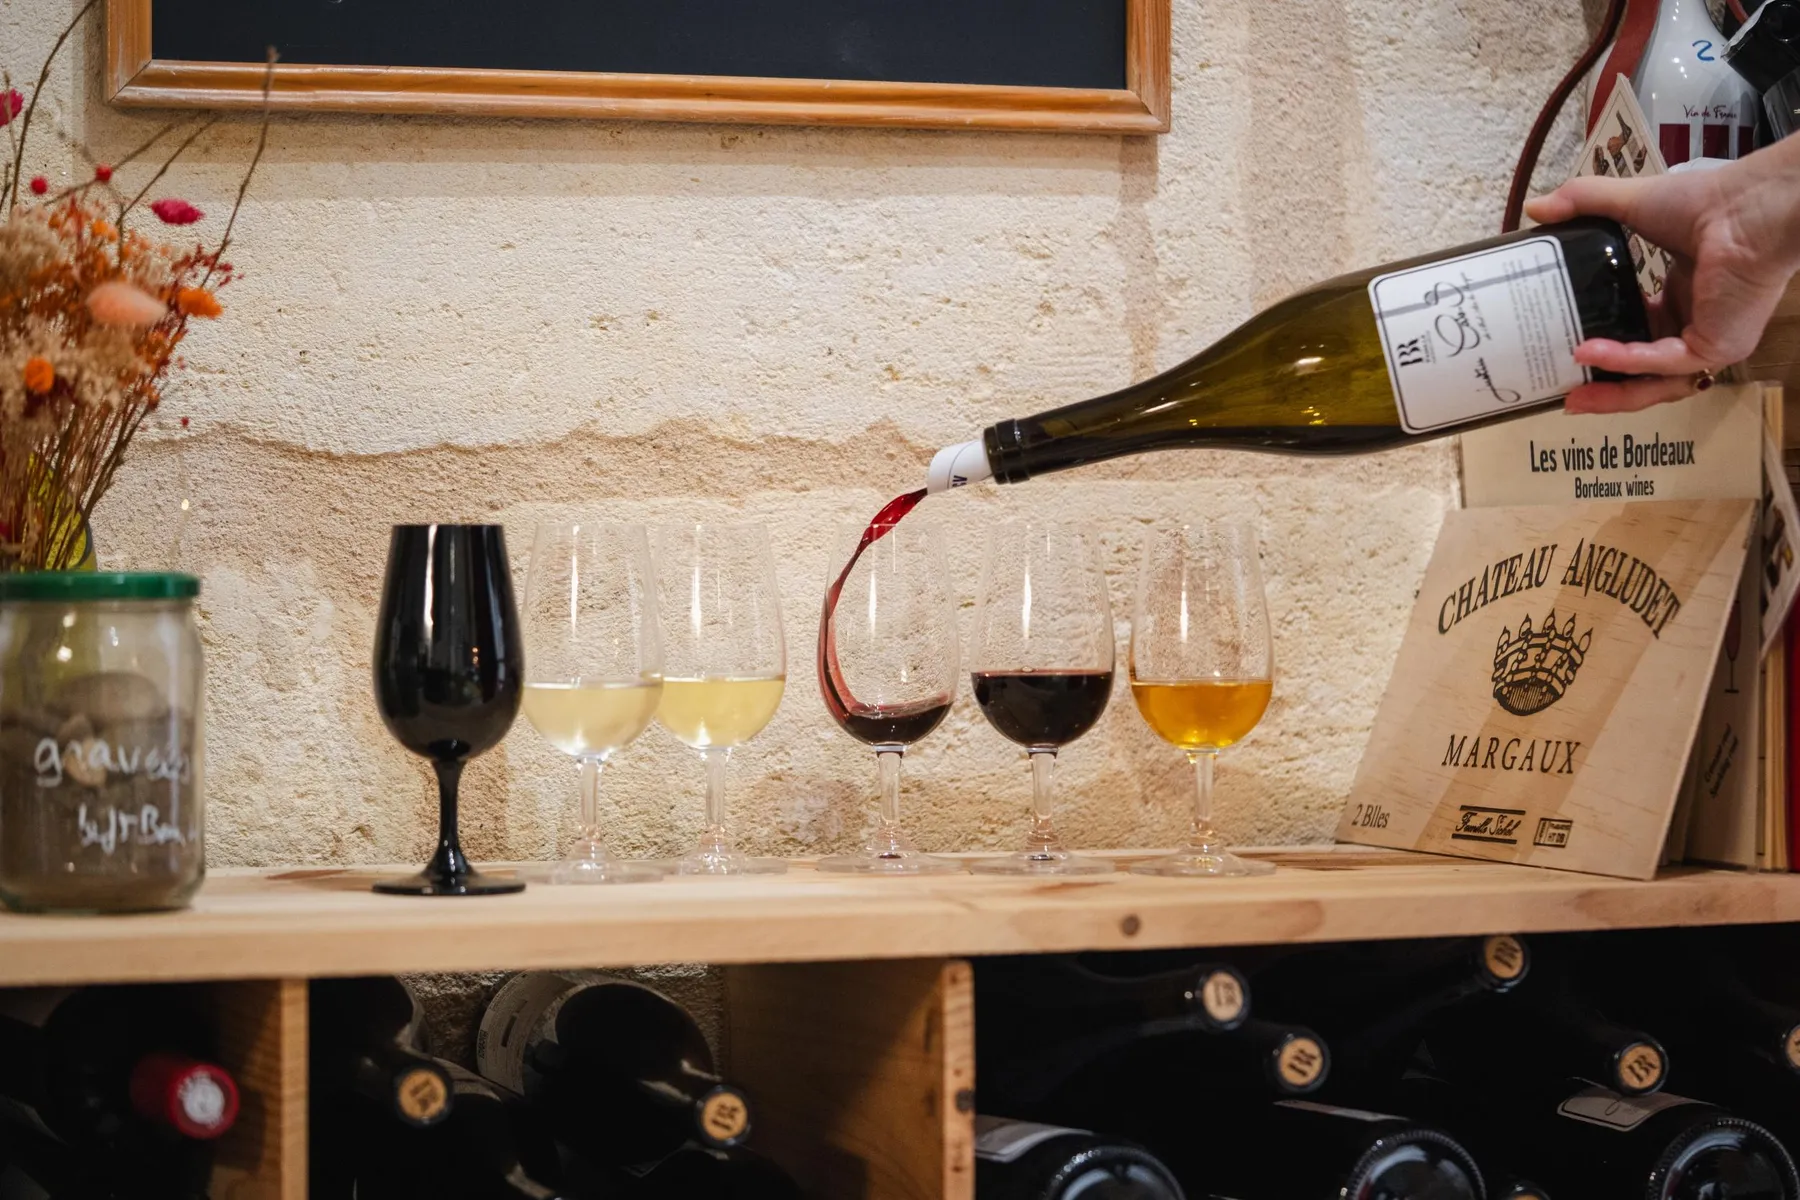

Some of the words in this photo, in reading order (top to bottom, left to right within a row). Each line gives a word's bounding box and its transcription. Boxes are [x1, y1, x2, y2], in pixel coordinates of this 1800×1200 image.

[1692, 39, 1715, 62] 2
[1683, 104, 1699, 119] Vin
[1530, 440, 1557, 473] Les
[1562, 437, 1595, 472] vins
[1600, 435, 1619, 470] de
[1623, 432, 1695, 469] Bordeaux
[1574, 476, 1623, 499] Bordeaux
[1625, 474, 1655, 497] wines
[1438, 543, 1558, 636] CHATEAU
[1560, 537, 1682, 641] ANGLUDET
[1441, 733, 1581, 774] MARGAUX
[1351, 803, 1363, 826] 2
